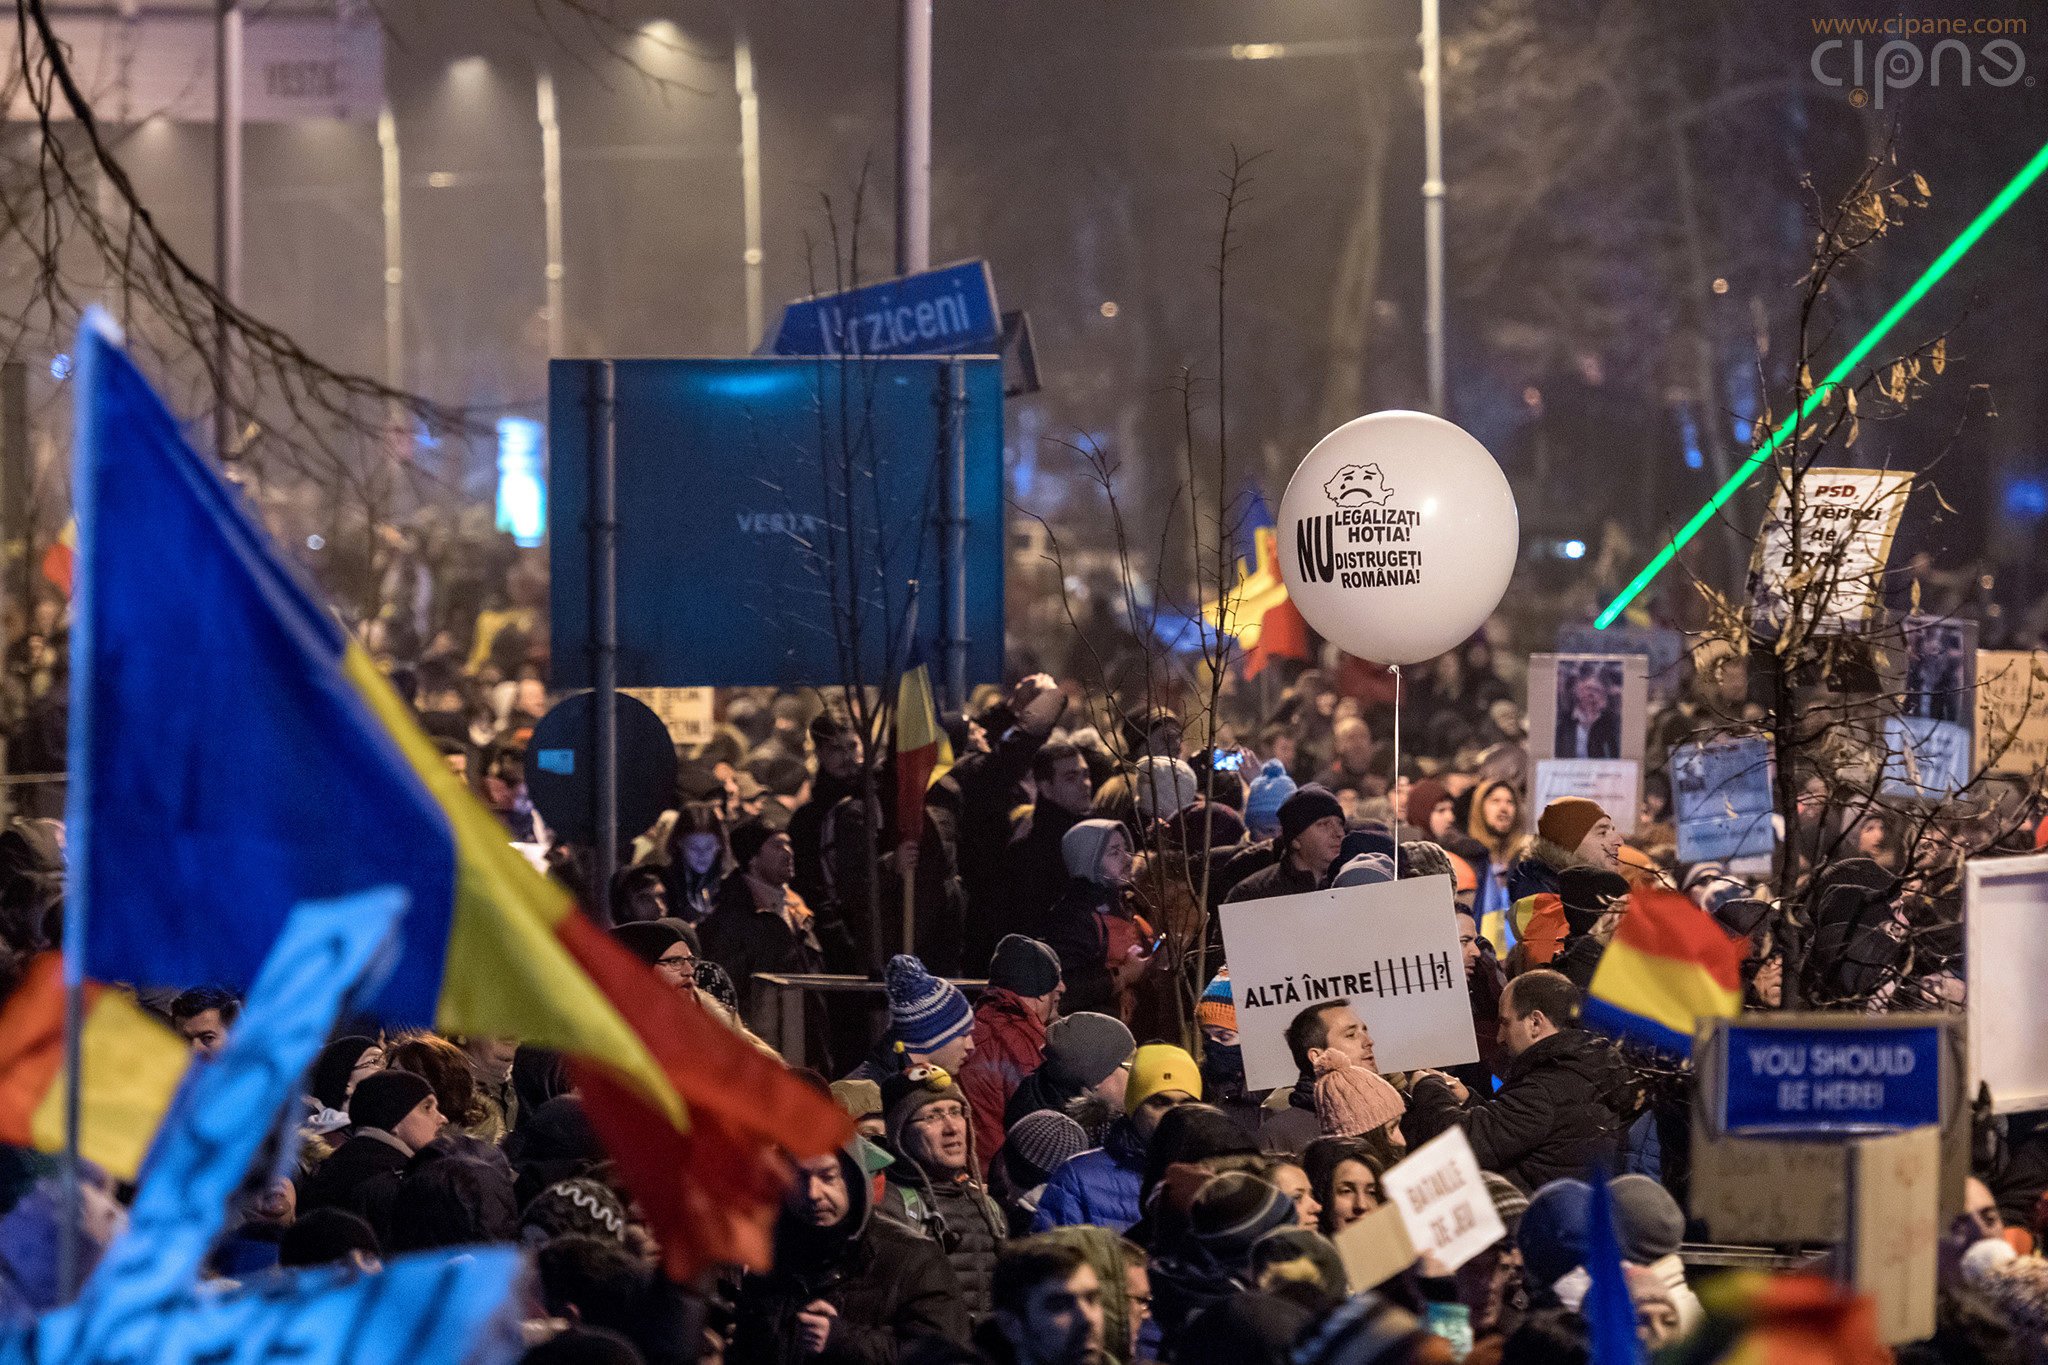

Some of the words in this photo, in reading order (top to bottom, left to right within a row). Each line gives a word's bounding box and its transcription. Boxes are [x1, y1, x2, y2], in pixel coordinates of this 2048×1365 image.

[1814, 485, 1860, 500] PSD,
[1296, 514, 1334, 583] NU
[1810, 528, 1838, 542] de
[1340, 567, 1420, 589] ROMÂNIA!
[1244, 976, 1302, 1009] ALTĂ
[1302, 972, 1374, 1001] ÎNTRE
[1748, 1045, 1807, 1076] YOU
[1809, 1045, 1916, 1076] SHOULD
[1777, 1081, 1809, 1111] BE
[1811, 1081, 1885, 1111] HERE!
